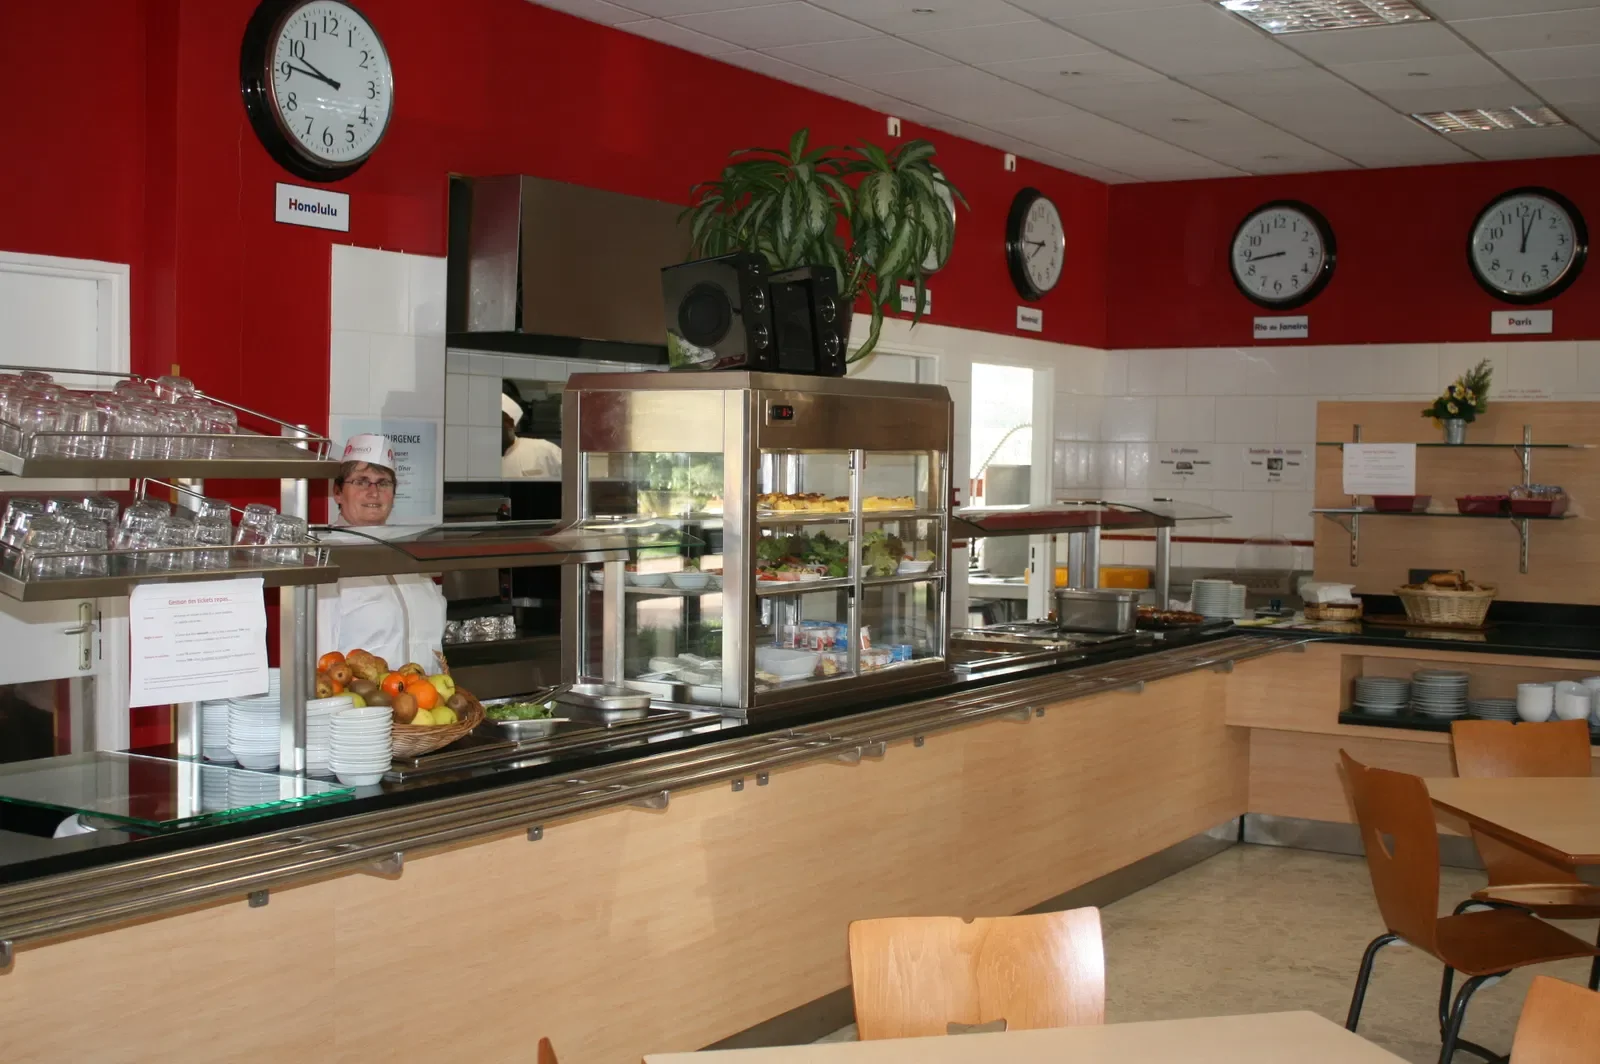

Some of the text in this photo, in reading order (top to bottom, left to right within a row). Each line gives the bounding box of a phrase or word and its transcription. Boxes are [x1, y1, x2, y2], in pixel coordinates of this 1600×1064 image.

[304, 20, 318, 40] 11
[322, 16, 339, 37] 12
[348, 29, 353, 47] 1
[289, 39, 305, 60] 10
[359, 51, 369, 69] 2
[281, 62, 292, 82] 9
[367, 81, 376, 99] 3
[287, 92, 297, 110] 8
[359, 106, 369, 124] 4
[304, 116, 314, 135] 7
[323, 126, 334, 147] 6
[345, 124, 355, 142] 5
[288, 198, 338, 217] Honolulu
[1516, 205, 1530, 218] 12
[1501, 212, 1512, 225] 11
[1536, 208, 1542, 220] 1
[1260, 223, 1270, 234] 11
[1274, 218, 1286, 228] 12
[1292, 221, 1297, 232] 1
[1550, 217, 1557, 229] 2
[1302, 232, 1309, 242] 2
[1490, 227, 1503, 240] 10
[1249, 236, 1261, 247] 10
[1557, 234, 1564, 246] 3
[1308, 247, 1315, 258] 3
[1484, 242, 1494, 254] 9
[1243, 250, 1252, 261] 9
[1551, 251, 1559, 262] 4
[1248, 265, 1256, 276] 8
[1301, 263, 1308, 274] 4
[1491, 259, 1500, 271] 8
[1541, 264, 1549, 278] 5
[1506, 269, 1514, 281] 7
[1522, 272, 1531, 284] 6
[1260, 276, 1267, 287] 7
[1274, 280, 1282, 291] 6
[1291, 276, 1298, 287] 5
[1279, 322, 1308, 331] Janeiro
